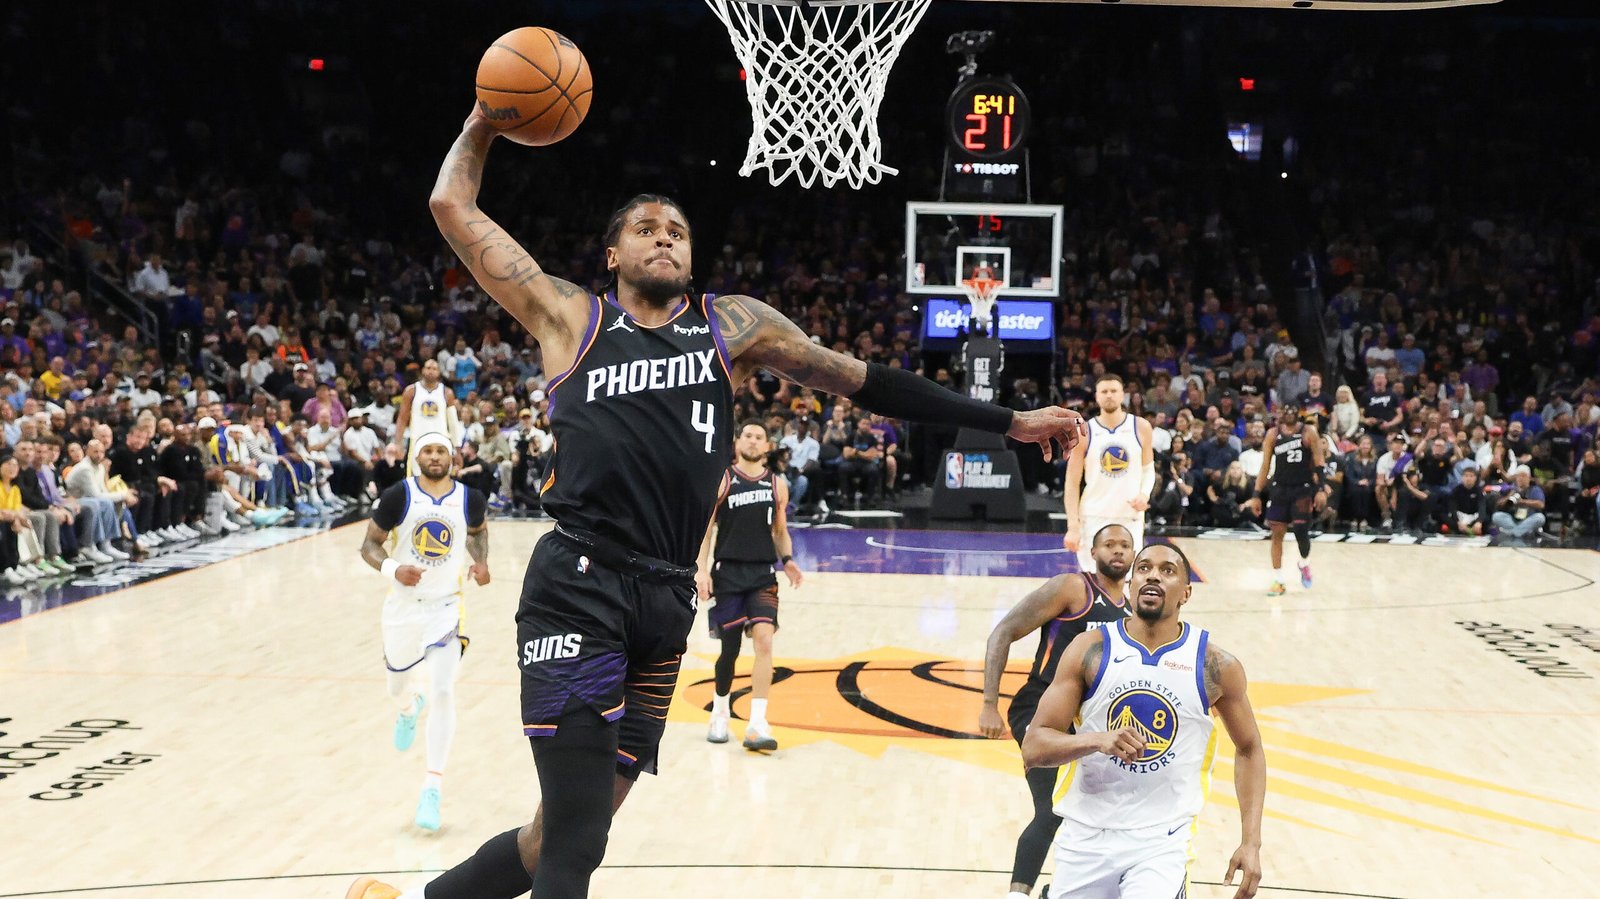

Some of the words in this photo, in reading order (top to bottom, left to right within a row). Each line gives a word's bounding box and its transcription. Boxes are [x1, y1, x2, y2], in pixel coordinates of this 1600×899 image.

[974, 95, 1014, 115] 6:41
[965, 114, 1011, 150] 21
[971, 163, 1019, 174] TISSOT
[977, 213, 1002, 231] 15
[673, 323, 710, 337] PayPal
[934, 309, 1044, 330] tickaster
[586, 348, 717, 404] PHOENIX
[691, 400, 716, 454] 4
[1286, 449, 1303, 463] 23
[727, 489, 773, 510] PHOENIX
[767, 506, 773, 526] 1
[439, 529, 449, 543] 0
[523, 633, 583, 666] SUNS
[1164, 660, 1193, 672] Rakuten
[1108, 680, 1152, 700] GOLDEN
[1155, 684, 1183, 708] STATE
[1152, 709, 1167, 730] 8
[1110, 750, 1176, 774] ARRIORS
